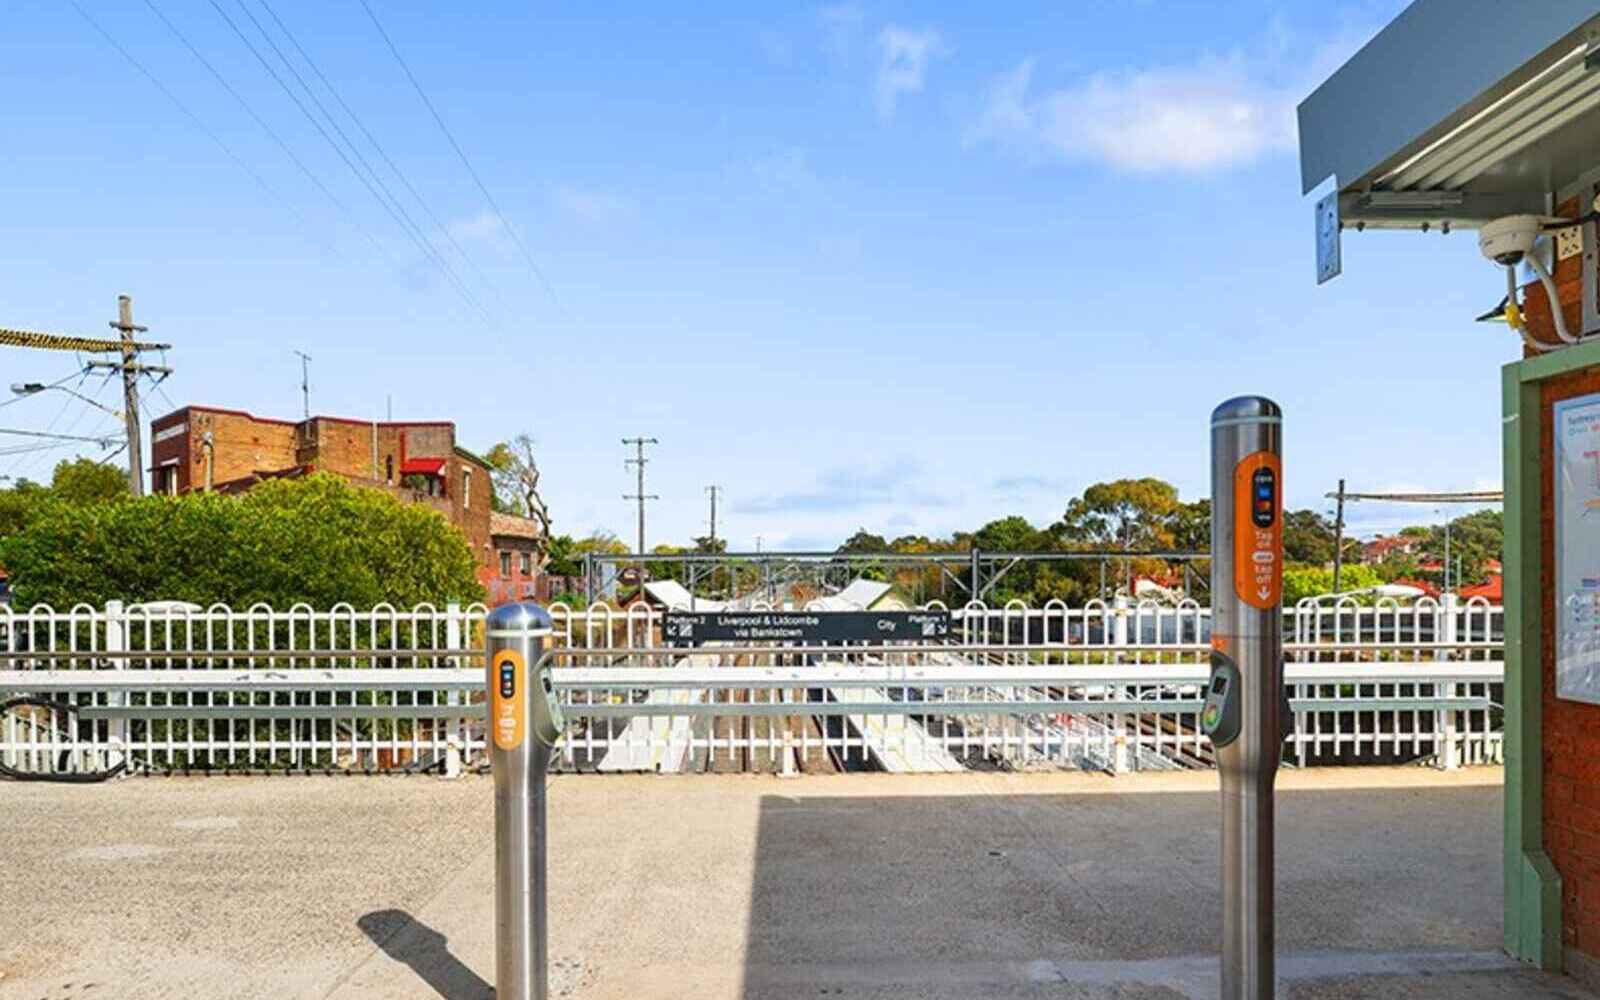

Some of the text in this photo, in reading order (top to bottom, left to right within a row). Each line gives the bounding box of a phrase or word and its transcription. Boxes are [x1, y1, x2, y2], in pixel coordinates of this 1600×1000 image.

[717, 615, 819, 626] Liverpool & Lidcombe
[877, 618, 897, 631] City
[734, 627, 803, 637] via Bankstown
